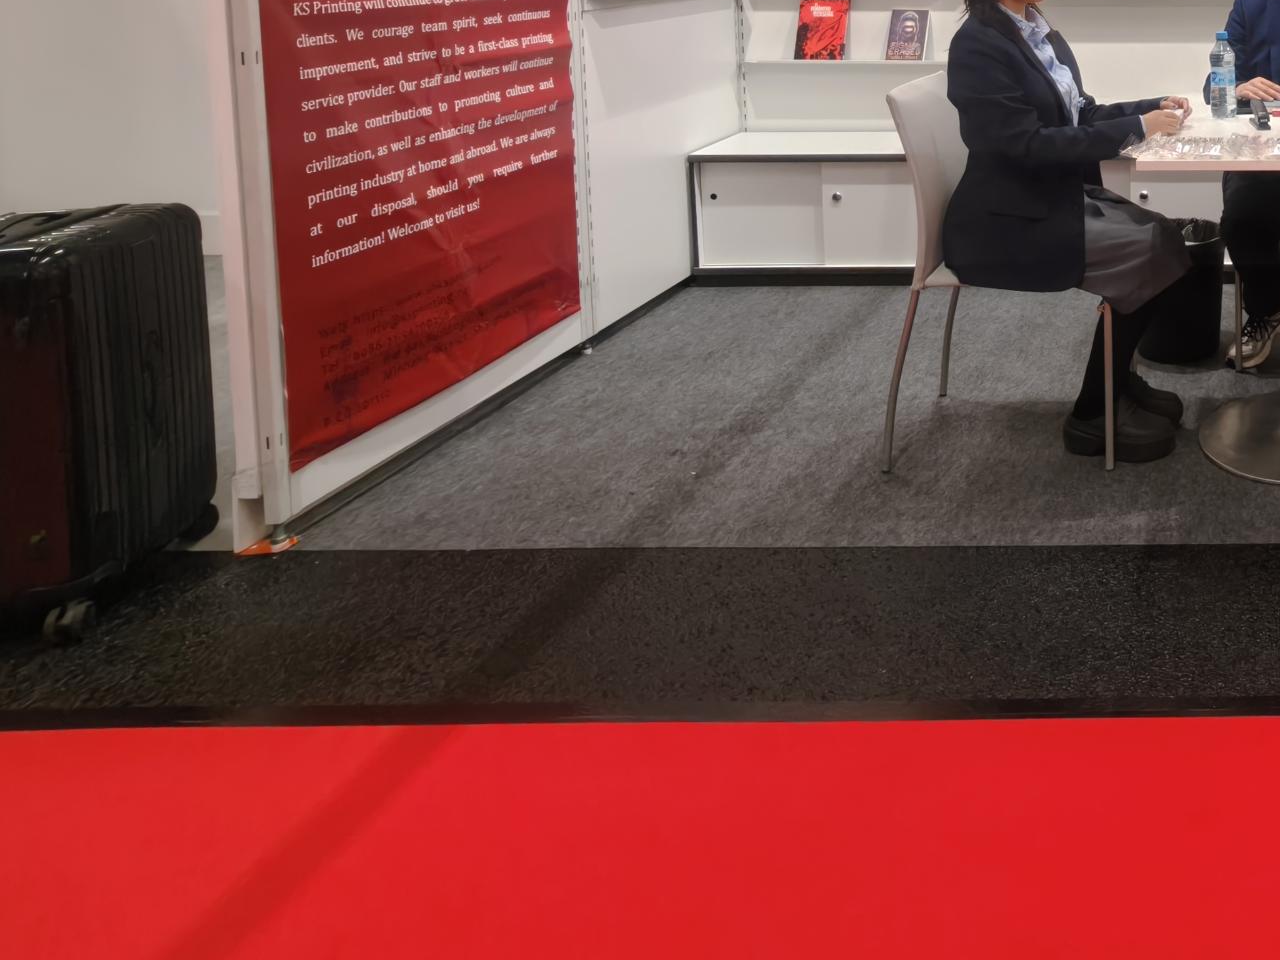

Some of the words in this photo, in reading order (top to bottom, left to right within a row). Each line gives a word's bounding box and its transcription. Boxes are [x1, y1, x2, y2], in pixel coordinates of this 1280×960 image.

[294, 2, 310, 16] KS
[313, 0, 362, 14] Printing
[297, 33, 337, 47] clients.
[346, 28, 364, 41] We
[372, 25, 414, 38] courage
[422, 22, 447, 32] team
[453, 16, 477, 31] spirit,
[484, 13, 502, 25] seek
[508, 10, 550, 22] continuous
[300, 57, 379, 80] improvement,
[384, 52, 403, 66] and
[408, 51, 437, 62] strive
[442, 48, 451, 57] to
[455, 44, 465, 55] be
[469, 45, 474, 53] a
[478, 37, 519, 52] first-class
[521, 33, 554, 48] printing
[311, 232, 385, 268] information!
[388, 218, 433, 240] Welcome
[435, 214, 444, 223] to
[446, 204, 465, 219] visit
[467, 198, 479, 212] us!
